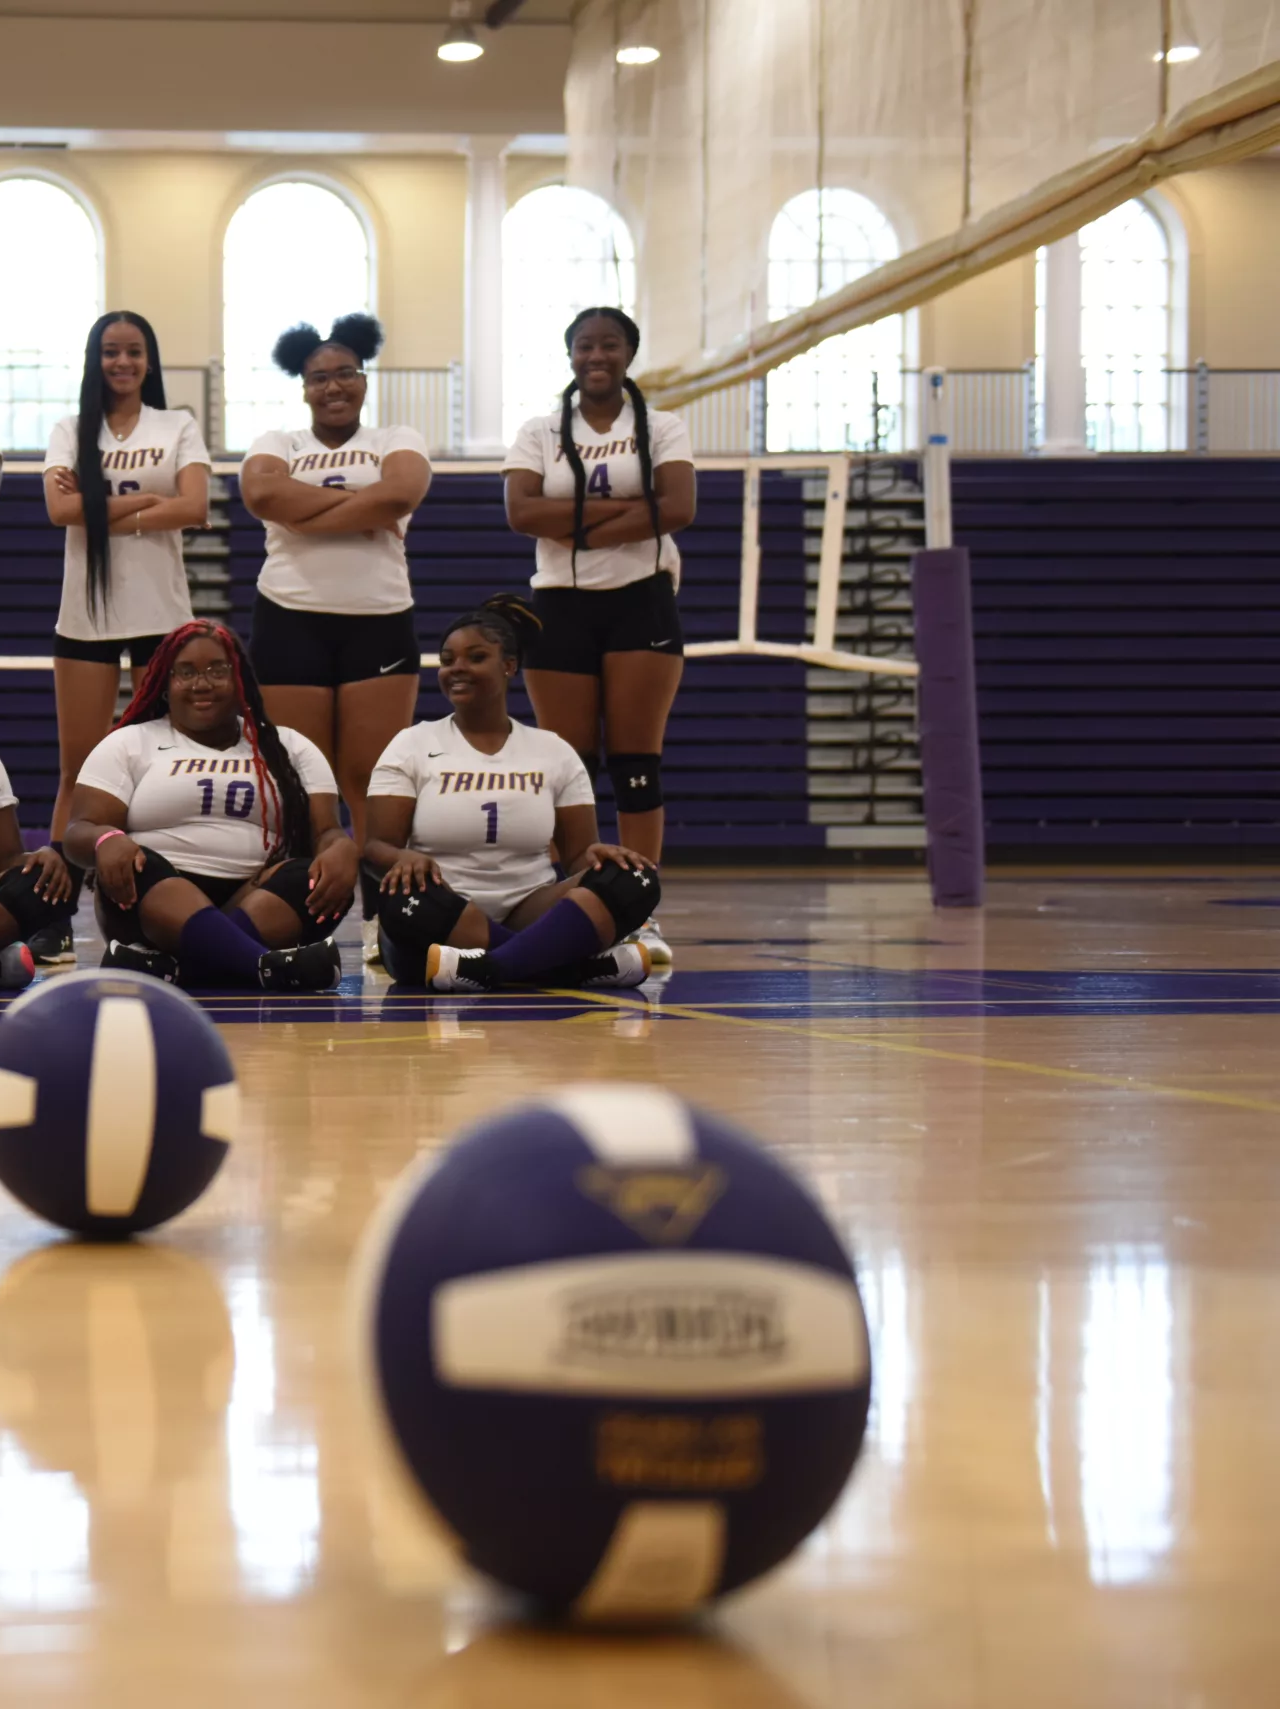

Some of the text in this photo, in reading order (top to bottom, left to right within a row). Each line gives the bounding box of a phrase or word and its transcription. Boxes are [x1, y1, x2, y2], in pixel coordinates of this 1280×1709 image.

[100, 447, 164, 471] INITY
[289, 449, 380, 476] TRINITY
[554, 436, 638, 463] TINIT
[587, 462, 613, 499] 4
[168, 758, 256, 777] TRINI
[438, 771, 544, 795] TRINITY
[196, 778, 256, 818] 10
[480, 801, 499, 844] 1
